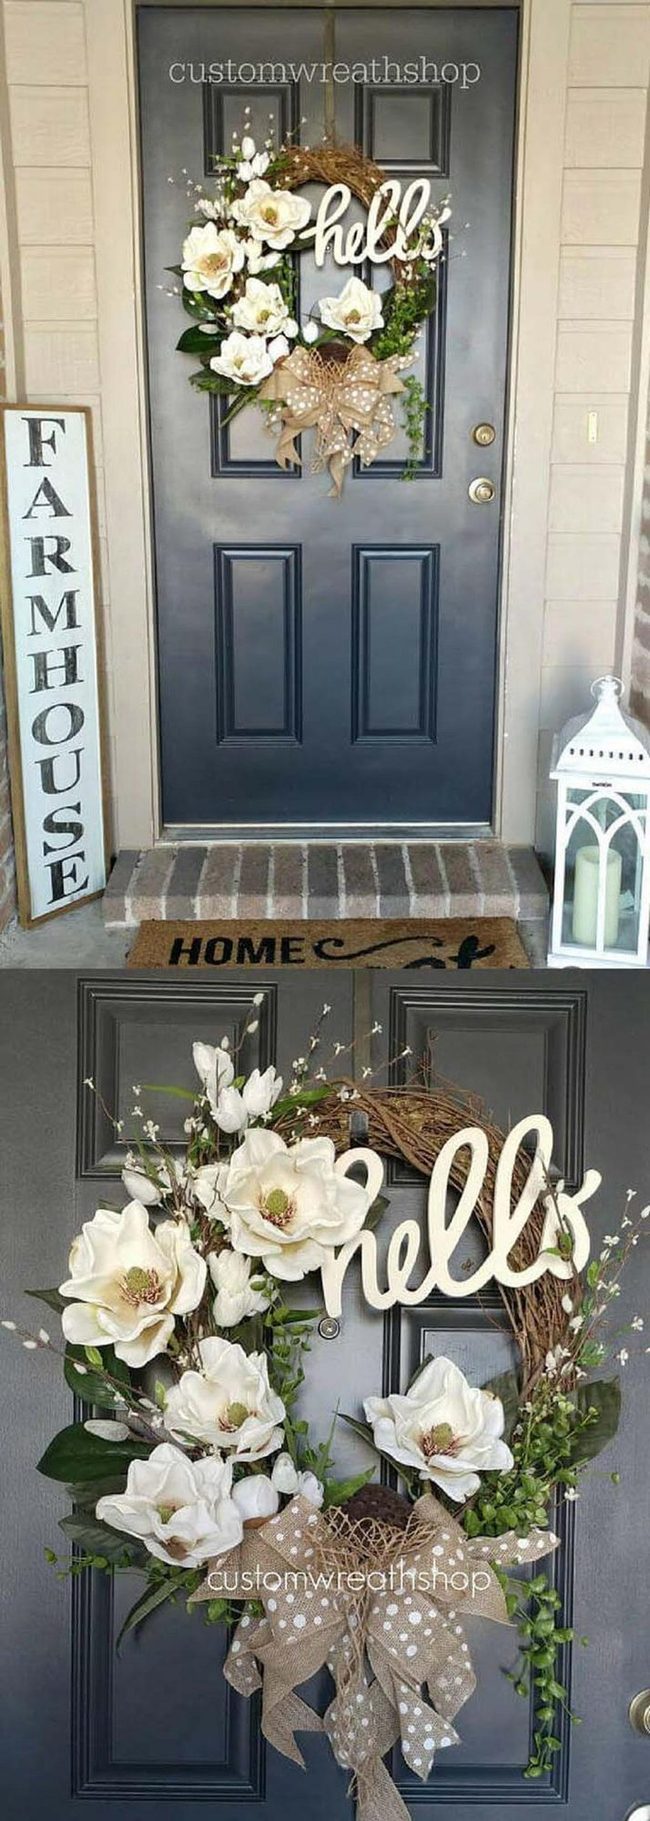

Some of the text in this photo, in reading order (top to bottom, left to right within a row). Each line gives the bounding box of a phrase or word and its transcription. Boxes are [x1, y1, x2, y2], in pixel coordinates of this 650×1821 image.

[299, 178, 452, 267] hello
[21, 416, 90, 904] FARMHOUSE
[169, 937, 305, 966] HOME
[321, 1114, 602, 1318] hello
